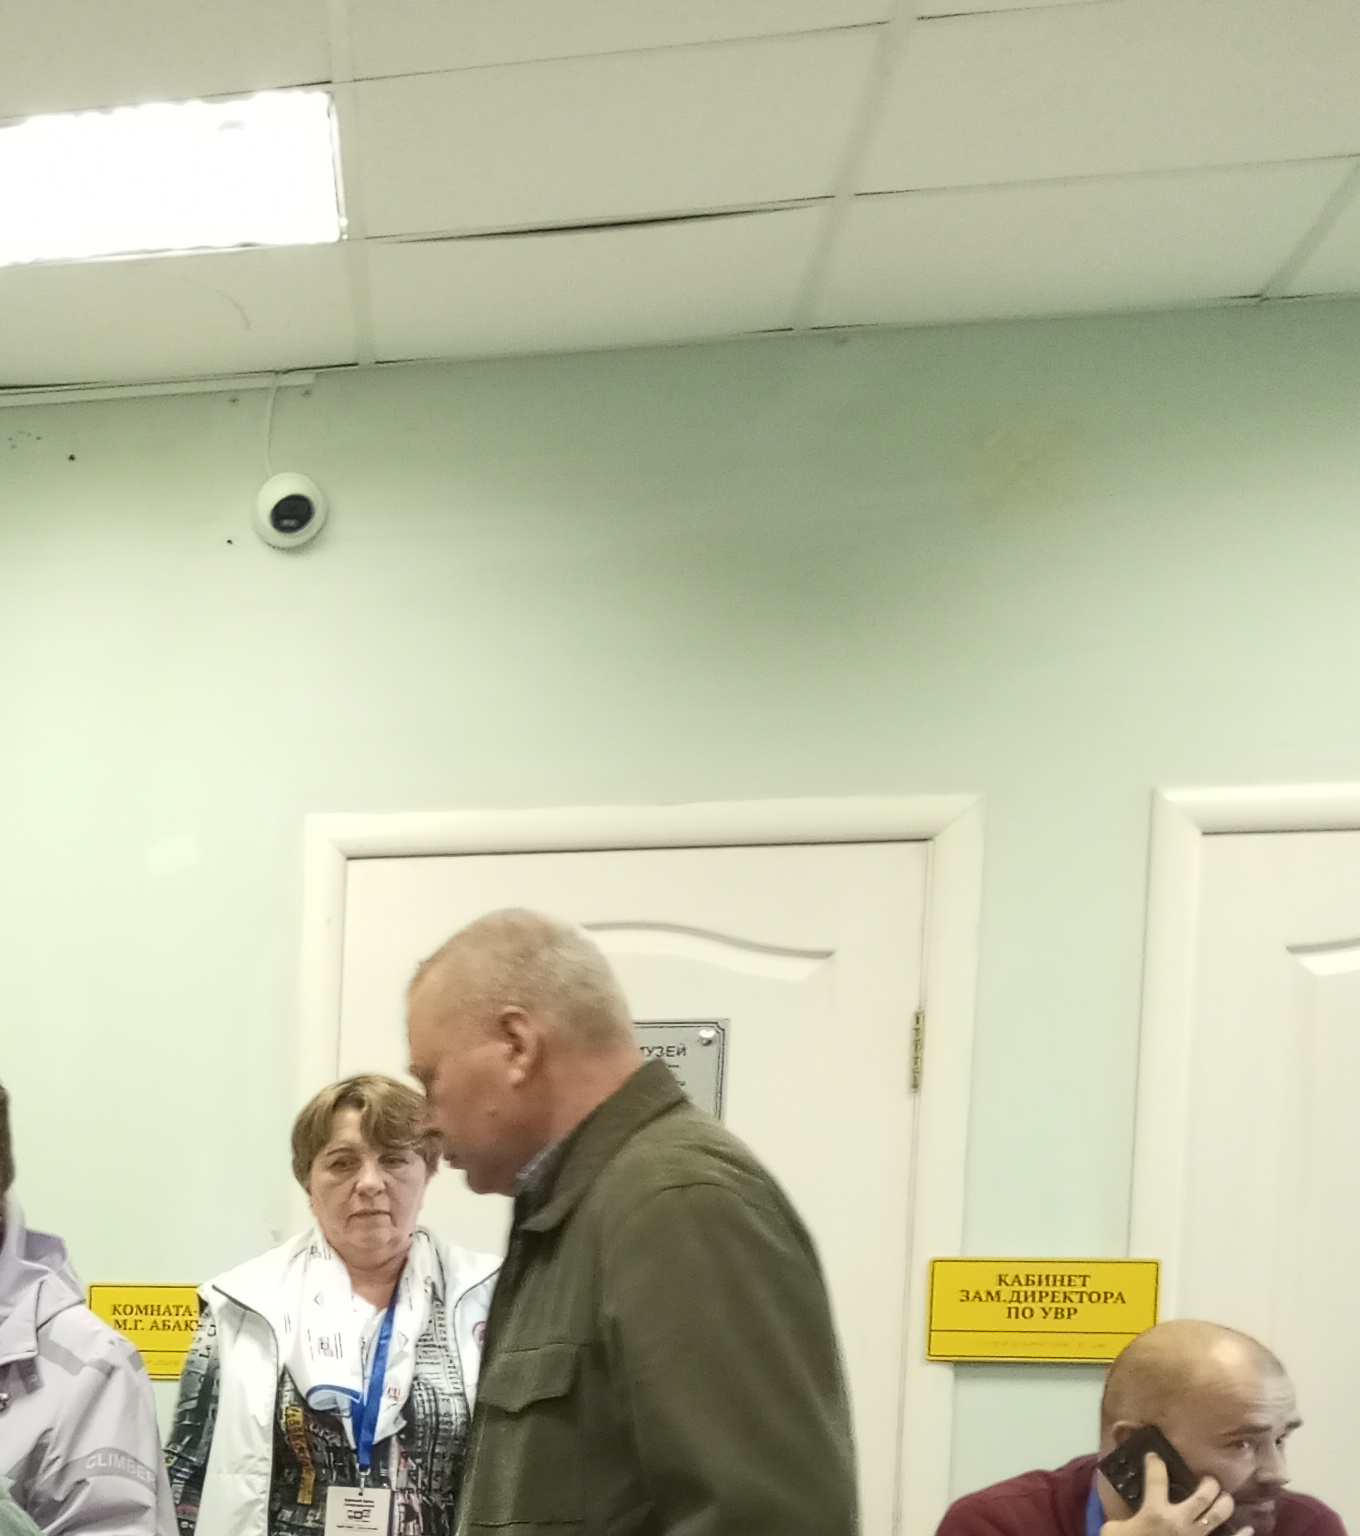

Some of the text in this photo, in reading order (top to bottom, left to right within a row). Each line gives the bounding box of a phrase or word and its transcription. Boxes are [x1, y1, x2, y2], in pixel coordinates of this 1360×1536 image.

[997, 1273, 1091, 1287] КАБИНЕТ
[112, 1303, 197, 1317] КОМНАТА-
[1007, 1306, 1078, 1320] ПО УВР
[149, 1319, 198, 1332] АБАК
